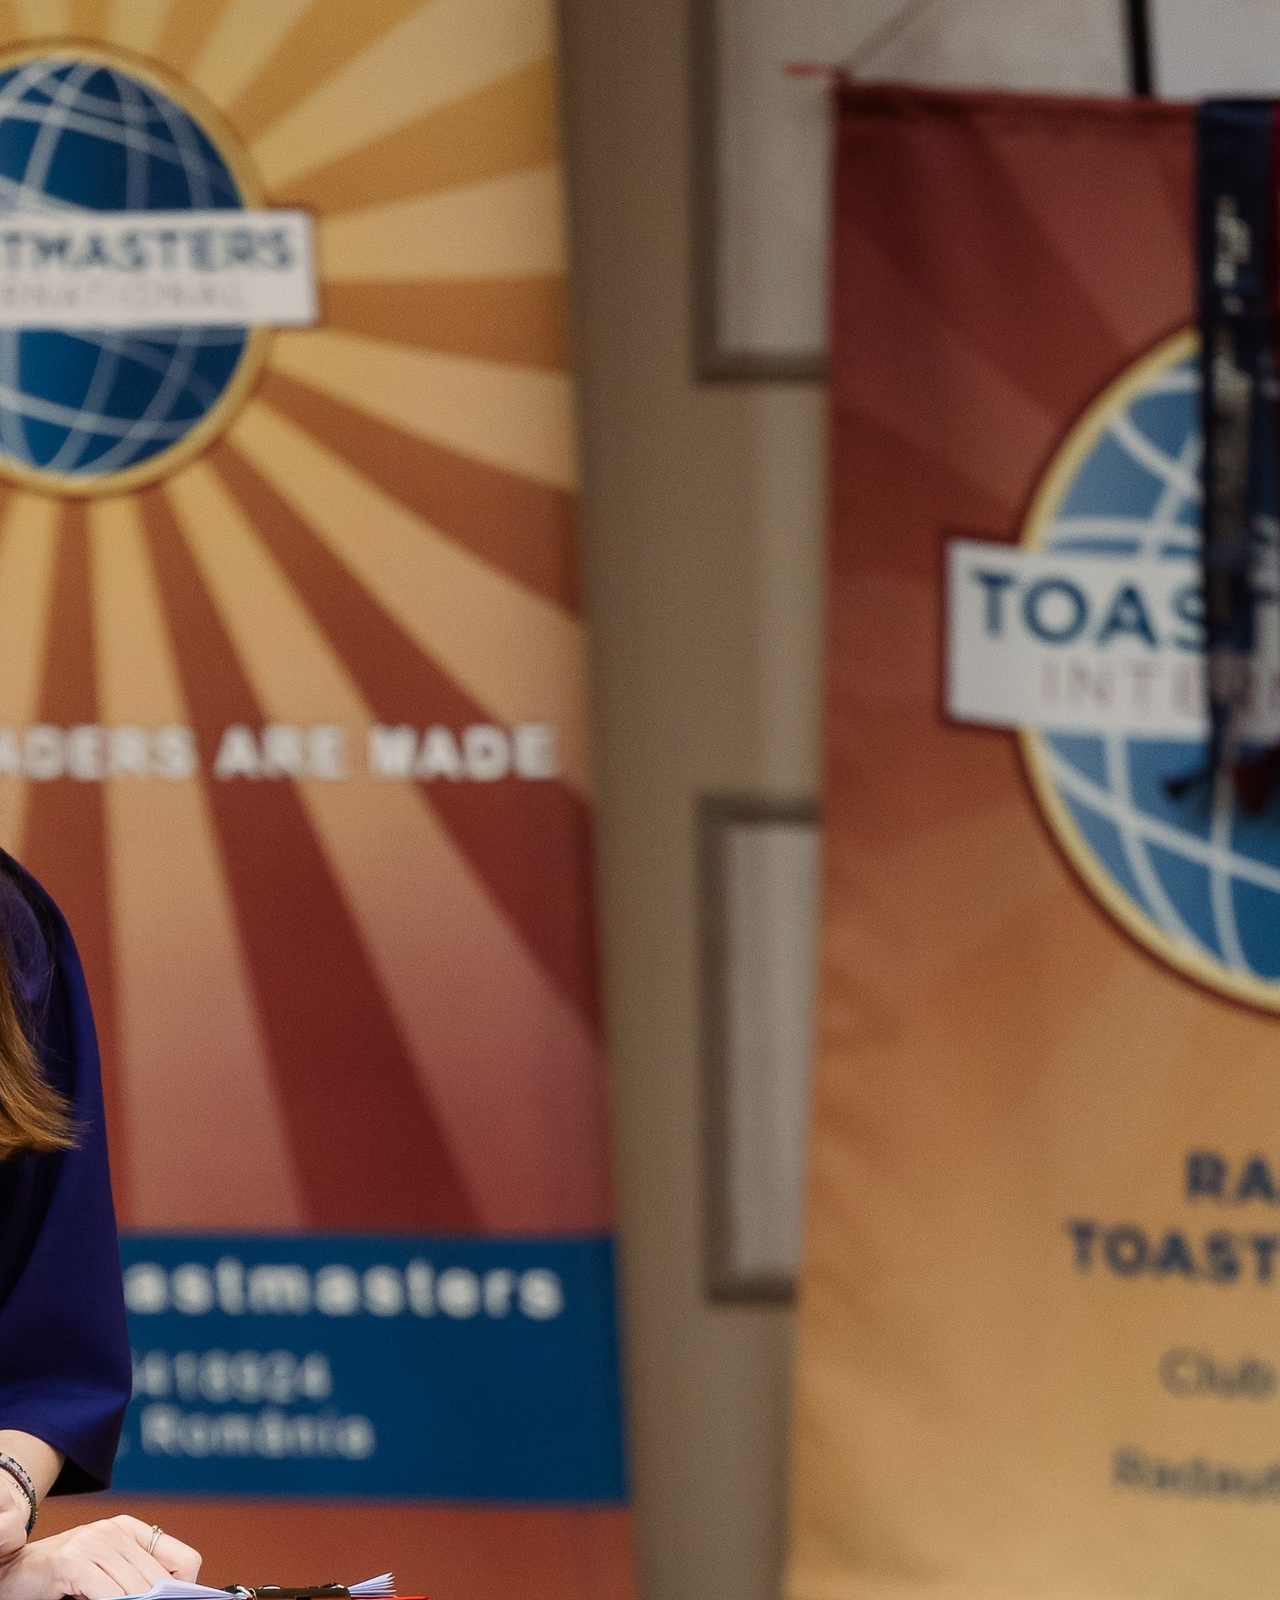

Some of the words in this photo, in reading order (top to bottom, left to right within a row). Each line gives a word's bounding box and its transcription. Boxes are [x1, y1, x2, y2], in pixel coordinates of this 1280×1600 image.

[970, 565, 1206, 651] TOAS
[214, 723, 346, 782] ARE
[368, 722, 558, 782] MADE
[1184, 1150, 1280, 1205] RA
[1065, 1217, 1280, 1285] TOAST
[122, 1255, 566, 1321] astmasters
